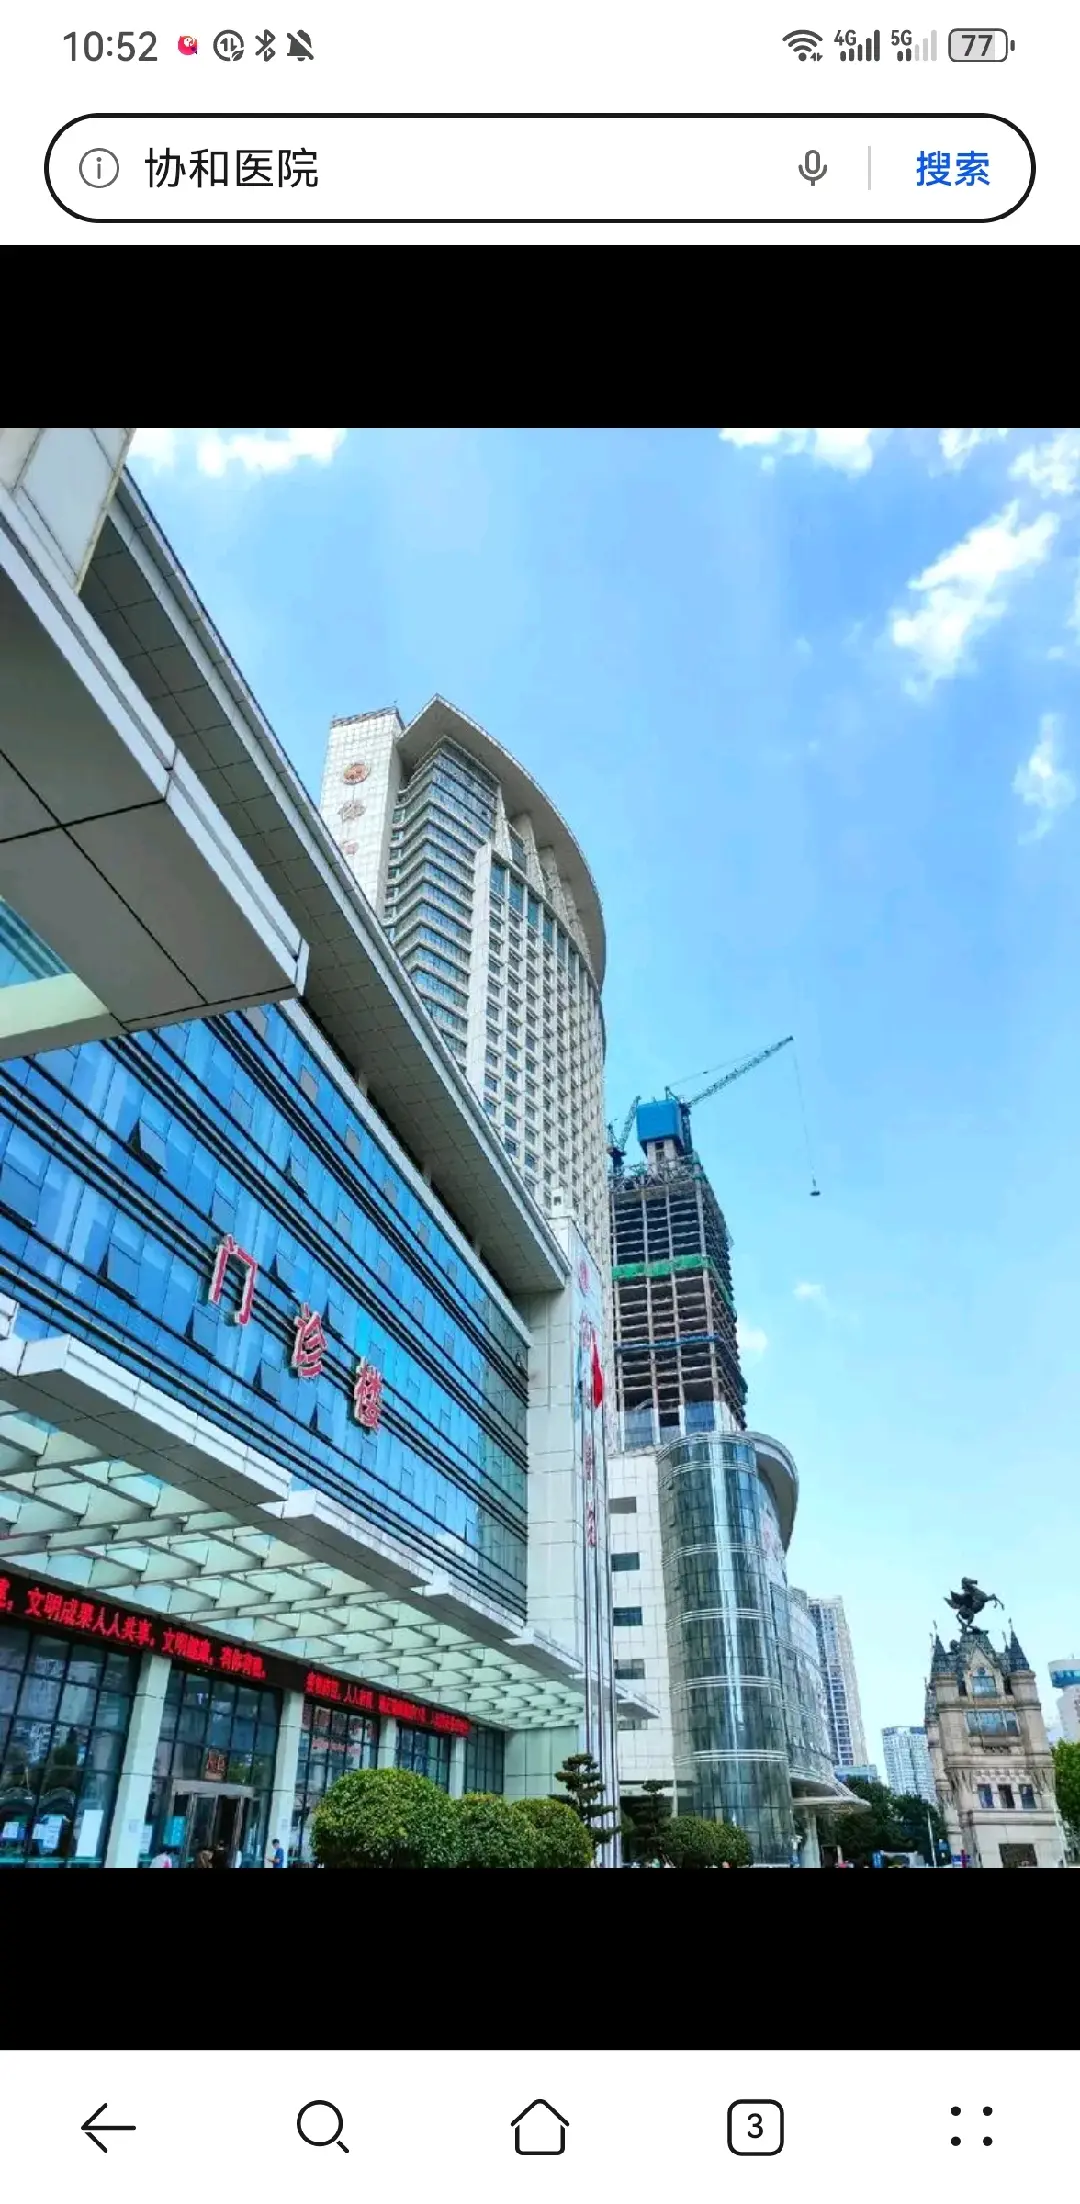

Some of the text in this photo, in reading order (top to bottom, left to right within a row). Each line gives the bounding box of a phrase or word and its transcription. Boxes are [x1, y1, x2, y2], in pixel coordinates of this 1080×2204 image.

[64, 31, 157, 62] 10:52
[833, 29, 861, 47] 4G
[891, 29, 912, 47] 5G
[961, 34, 993, 57] 77
[144, 148, 319, 187] 协和医院
[916, 150, 991, 186] 搜索
[208, 1234, 384, 1430] 门诊楼
[748, 2113, 763, 2138] 3
